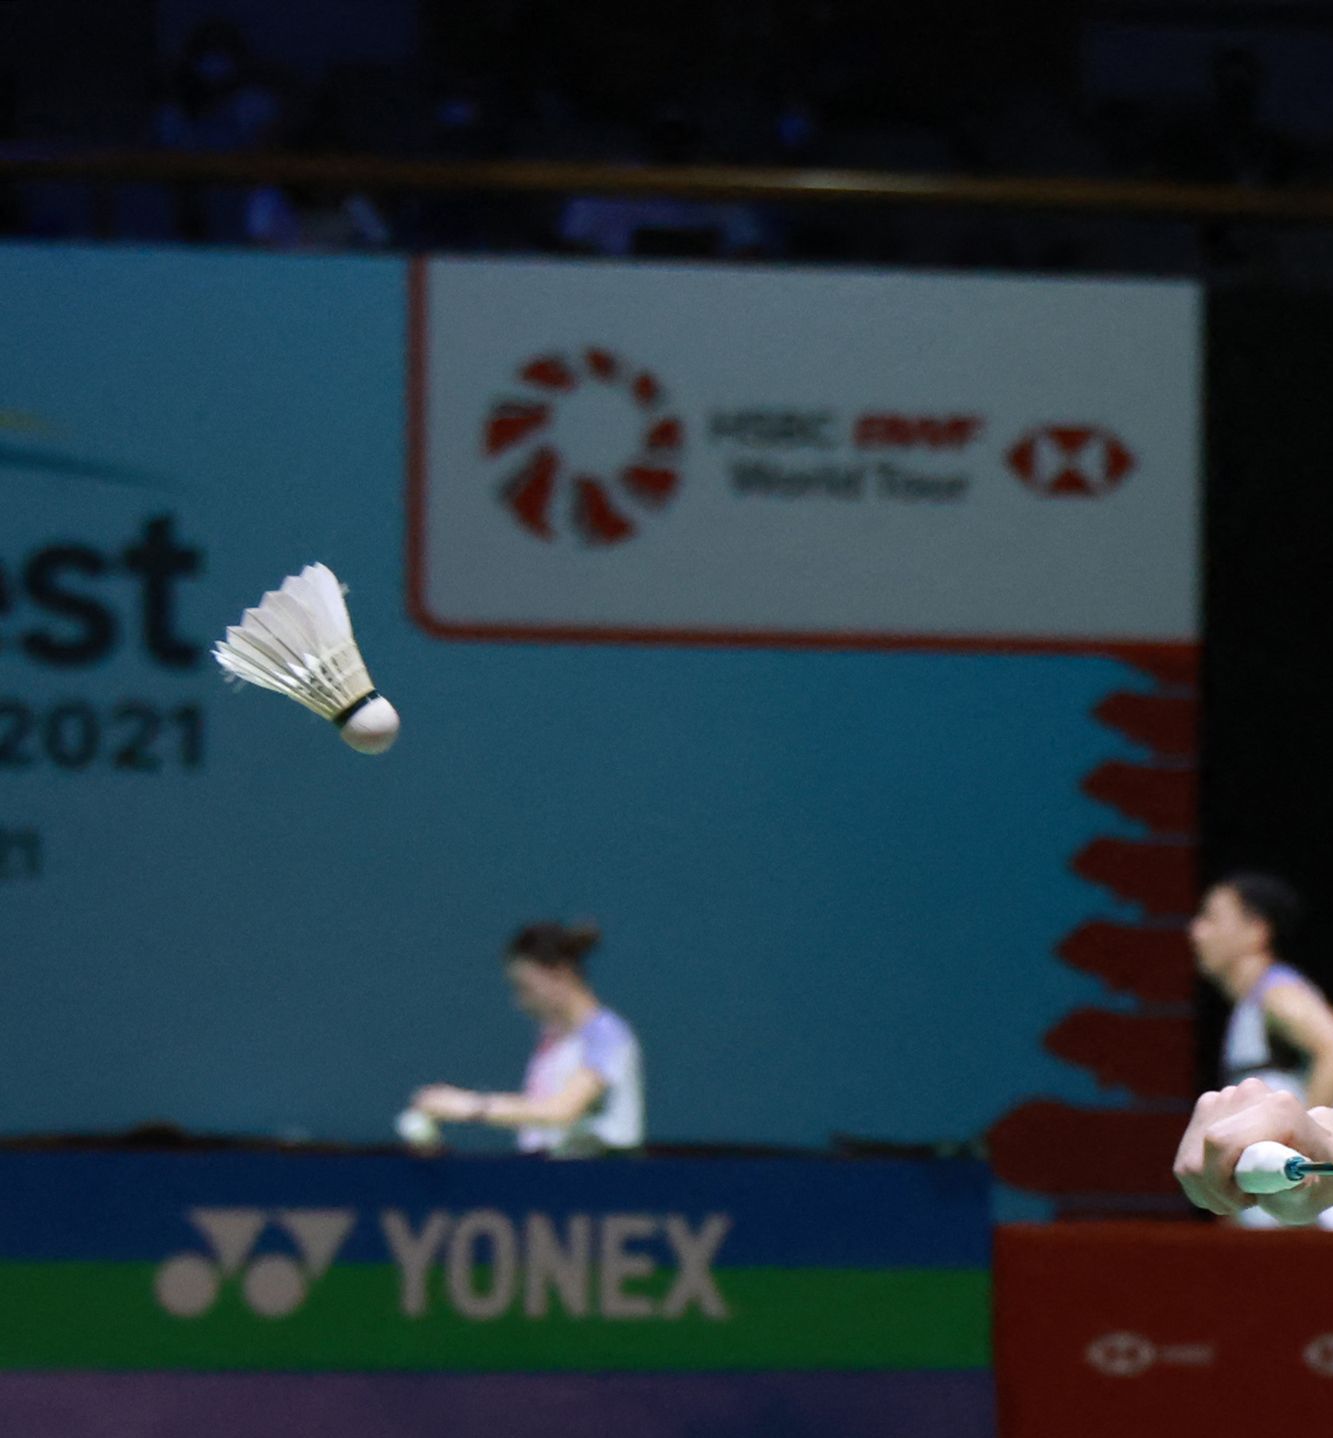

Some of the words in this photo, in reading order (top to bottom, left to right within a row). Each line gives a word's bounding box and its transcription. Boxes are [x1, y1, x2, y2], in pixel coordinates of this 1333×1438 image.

[730, 460, 862, 499] World
[874, 462, 969, 501] Tour
[0, 512, 205, 668] st
[0, 699, 204, 768] 2021
[379, 1206, 735, 1321] YONEX
